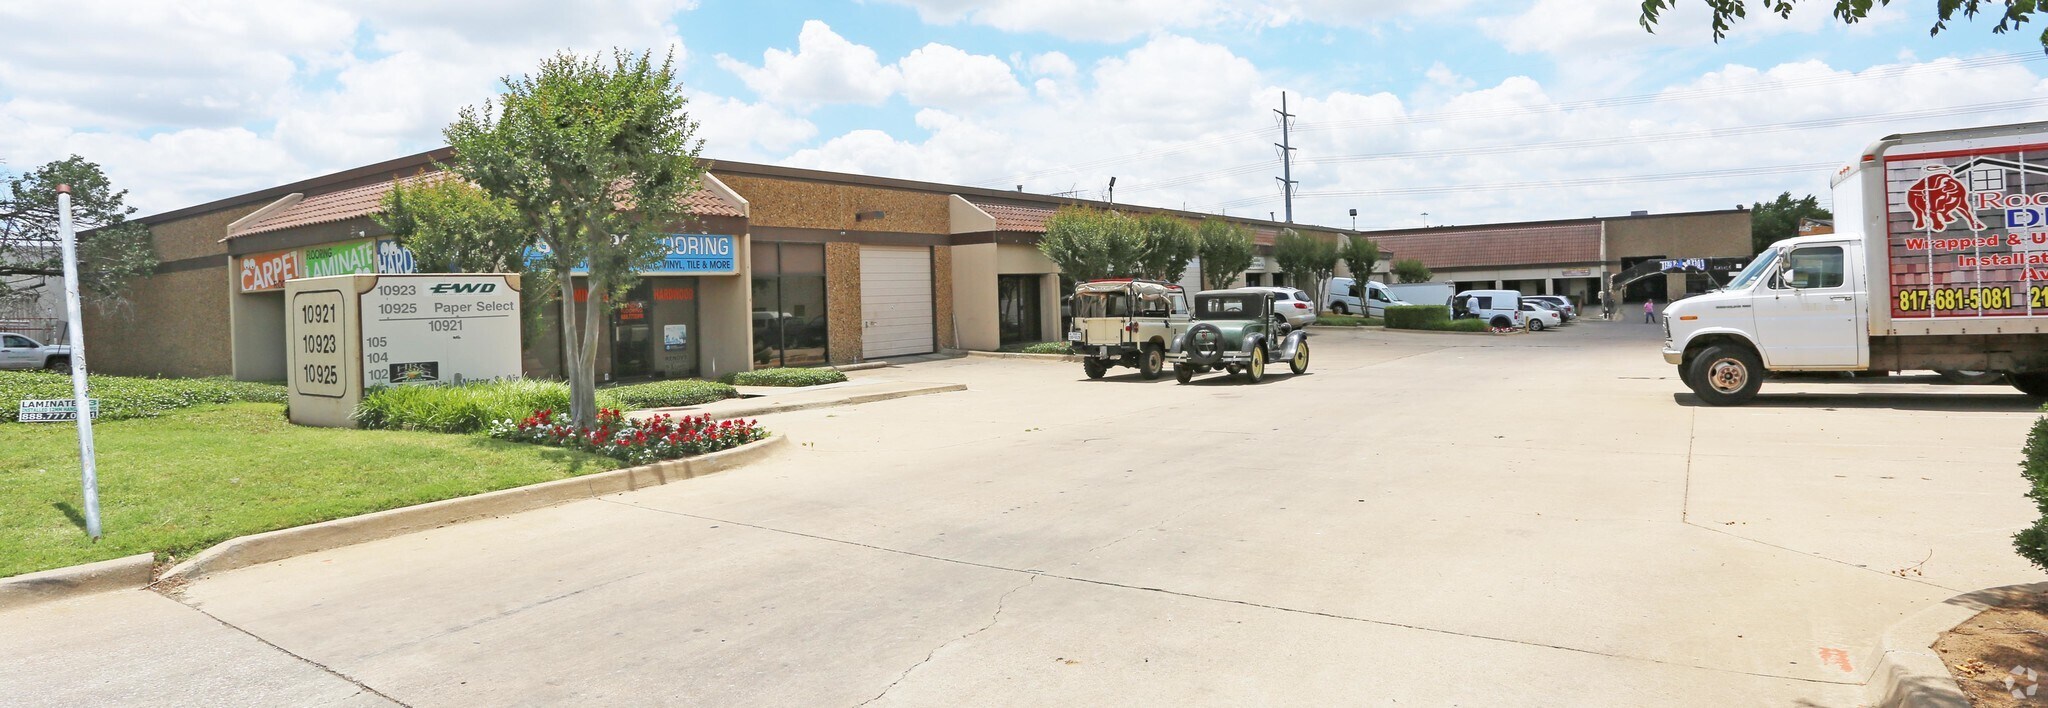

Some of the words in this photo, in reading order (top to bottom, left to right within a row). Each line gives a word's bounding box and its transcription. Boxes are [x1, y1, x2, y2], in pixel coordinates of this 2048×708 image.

[2006, 208, 2048, 228] D
[1906, 235, 1999, 251] Wrapped
[2006, 234, 2021, 246] &
[306, 247, 333, 260] FLOORING
[241, 250, 298, 291] CARPET
[687, 260, 700, 269] TILE
[702, 260, 708, 269] &
[709, 260, 730, 269] MORE
[378, 285, 416, 296] 10923
[1899, 287, 2012, 311] 817-681-5081
[302, 303, 335, 324] 10921
[378, 303, 417, 314] 10925
[434, 302, 472, 315] Paper
[476, 300, 514, 312] Select
[428, 319, 463, 332] 10921
[303, 334, 336, 353] 10923
[366, 336, 387, 348] 105
[367, 352, 388, 364] 104
[304, 364, 338, 385] 10925
[368, 369, 389, 381] 102
[22, 400, 77, 408] LAMINATE
[22, 411, 97, 420] 888.777.01
